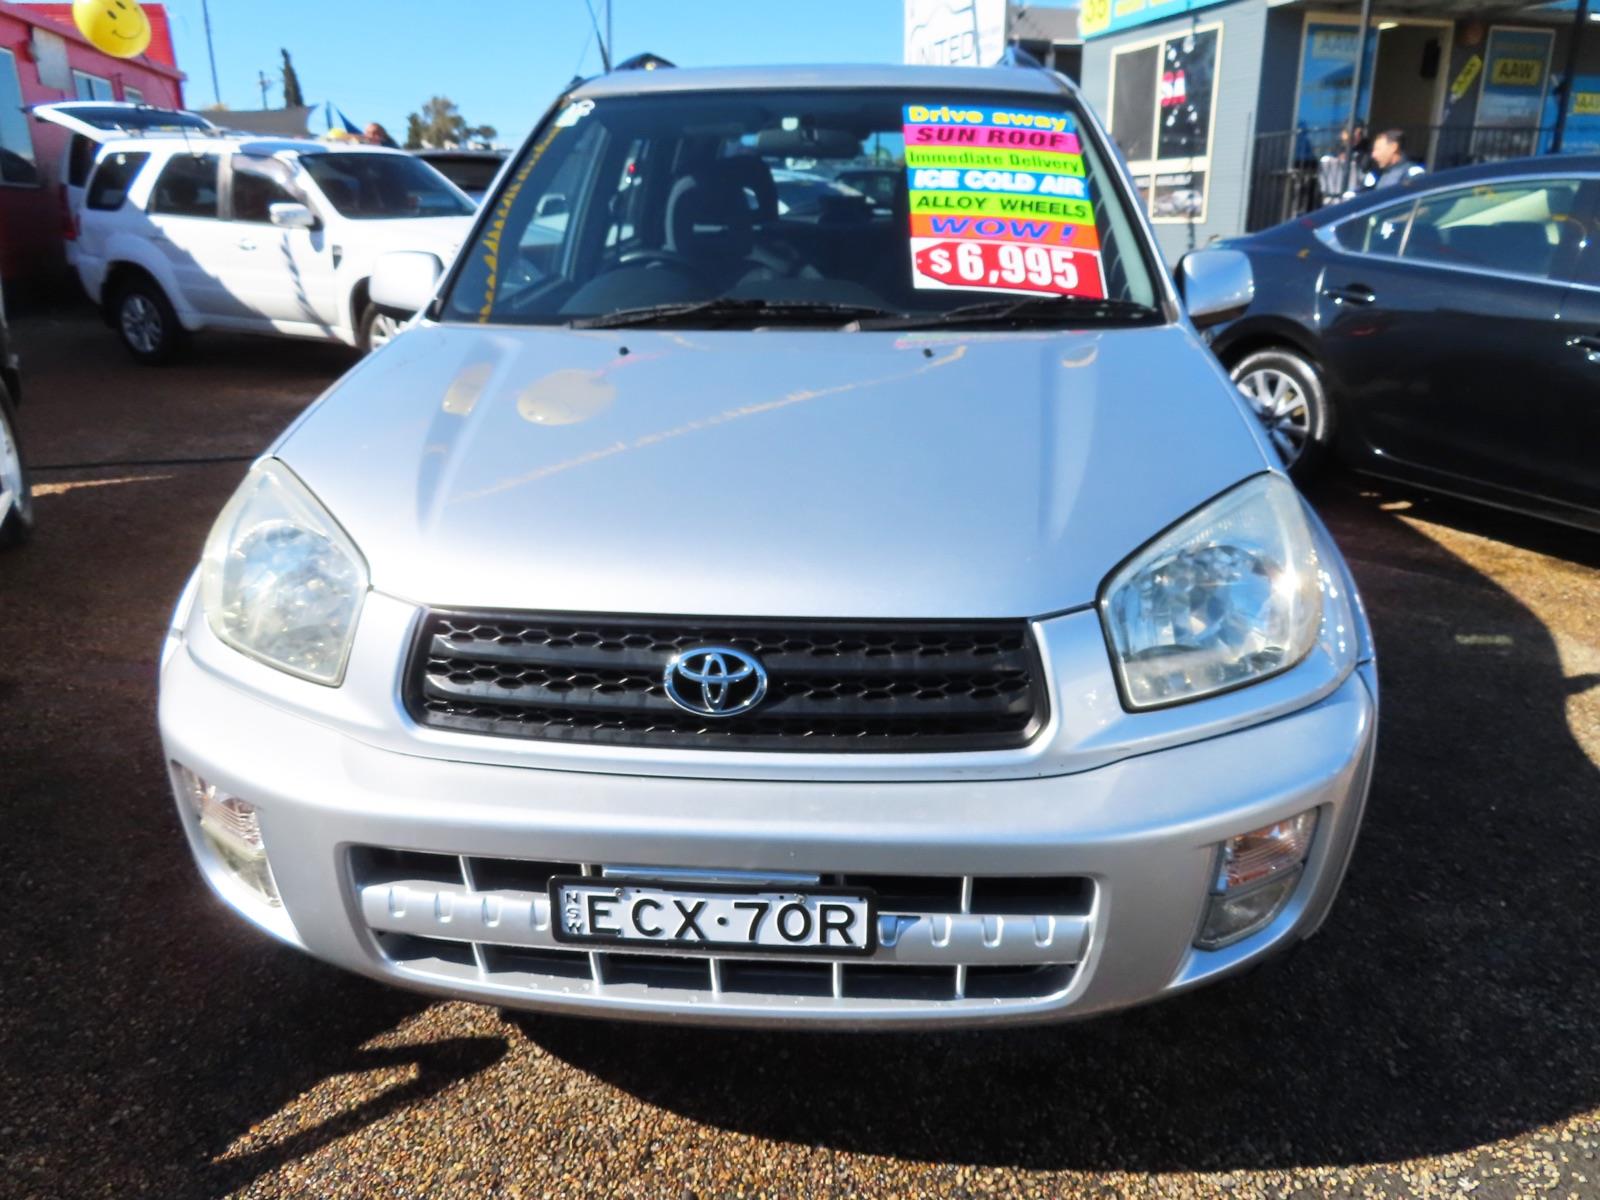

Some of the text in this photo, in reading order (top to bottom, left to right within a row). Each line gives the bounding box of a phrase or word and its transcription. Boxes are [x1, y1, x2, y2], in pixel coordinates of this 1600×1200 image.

[1499, 62, 1535, 79] AAW
[908, 105, 1067, 132] Drive away
[916, 127, 1066, 147] SUN ROOF
[910, 151, 1079, 172] Immediate Delivery
[914, 169, 1085, 197] ICE COLD AIR
[917, 195, 1087, 218] ALLOY WHEELS
[929, 242, 1079, 289] $6,995
